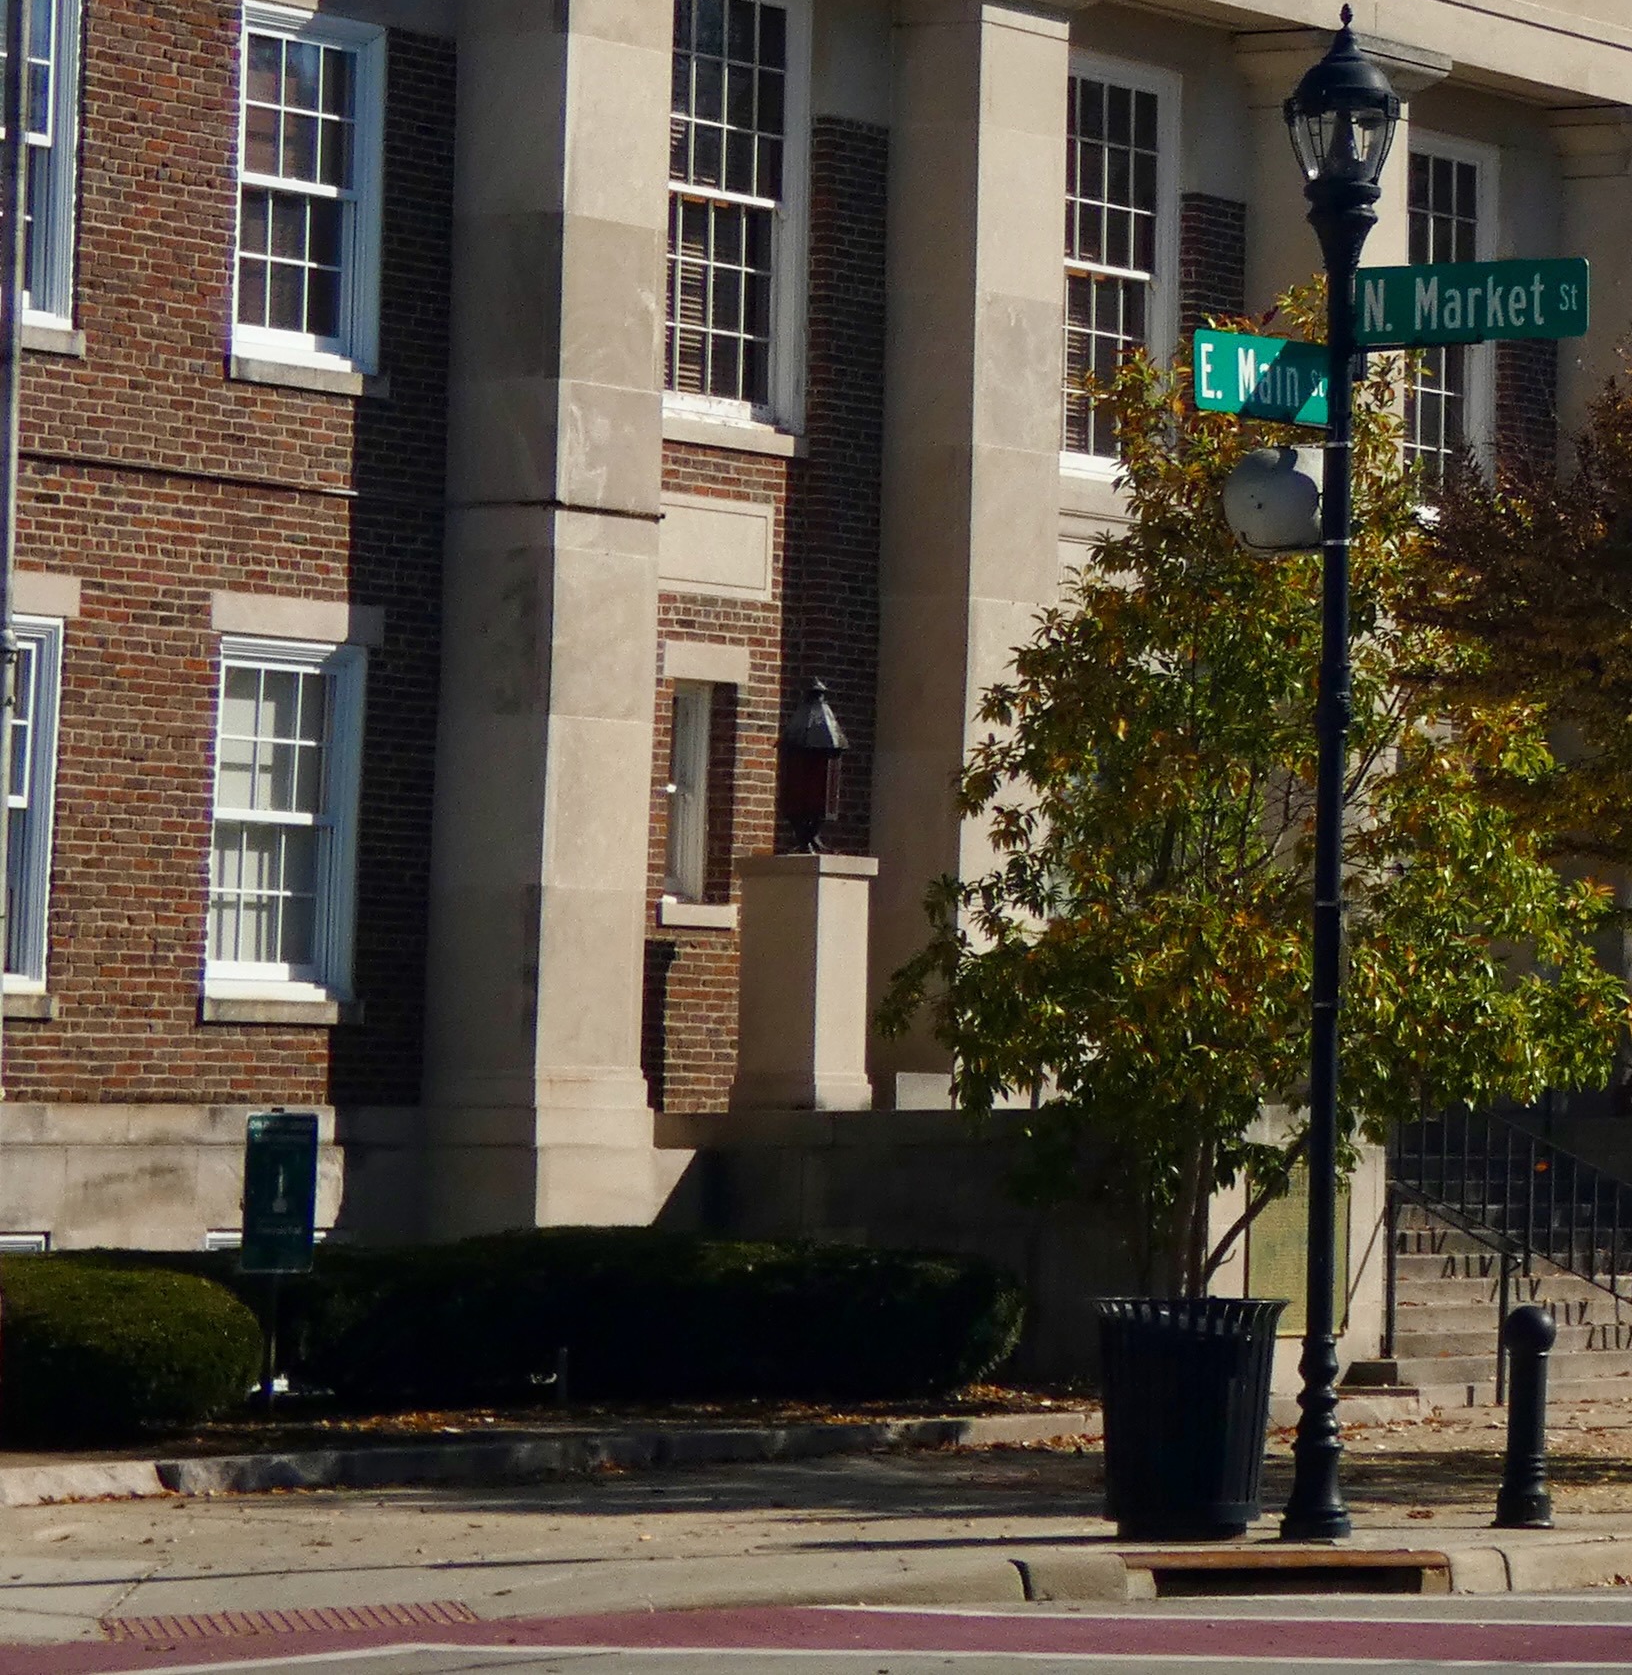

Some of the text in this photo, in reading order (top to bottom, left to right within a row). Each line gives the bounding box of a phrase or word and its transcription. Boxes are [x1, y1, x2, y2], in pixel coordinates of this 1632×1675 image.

[1364, 272, 1579, 332] N. Market St
[1200, 343, 1326, 408] E. Main St
